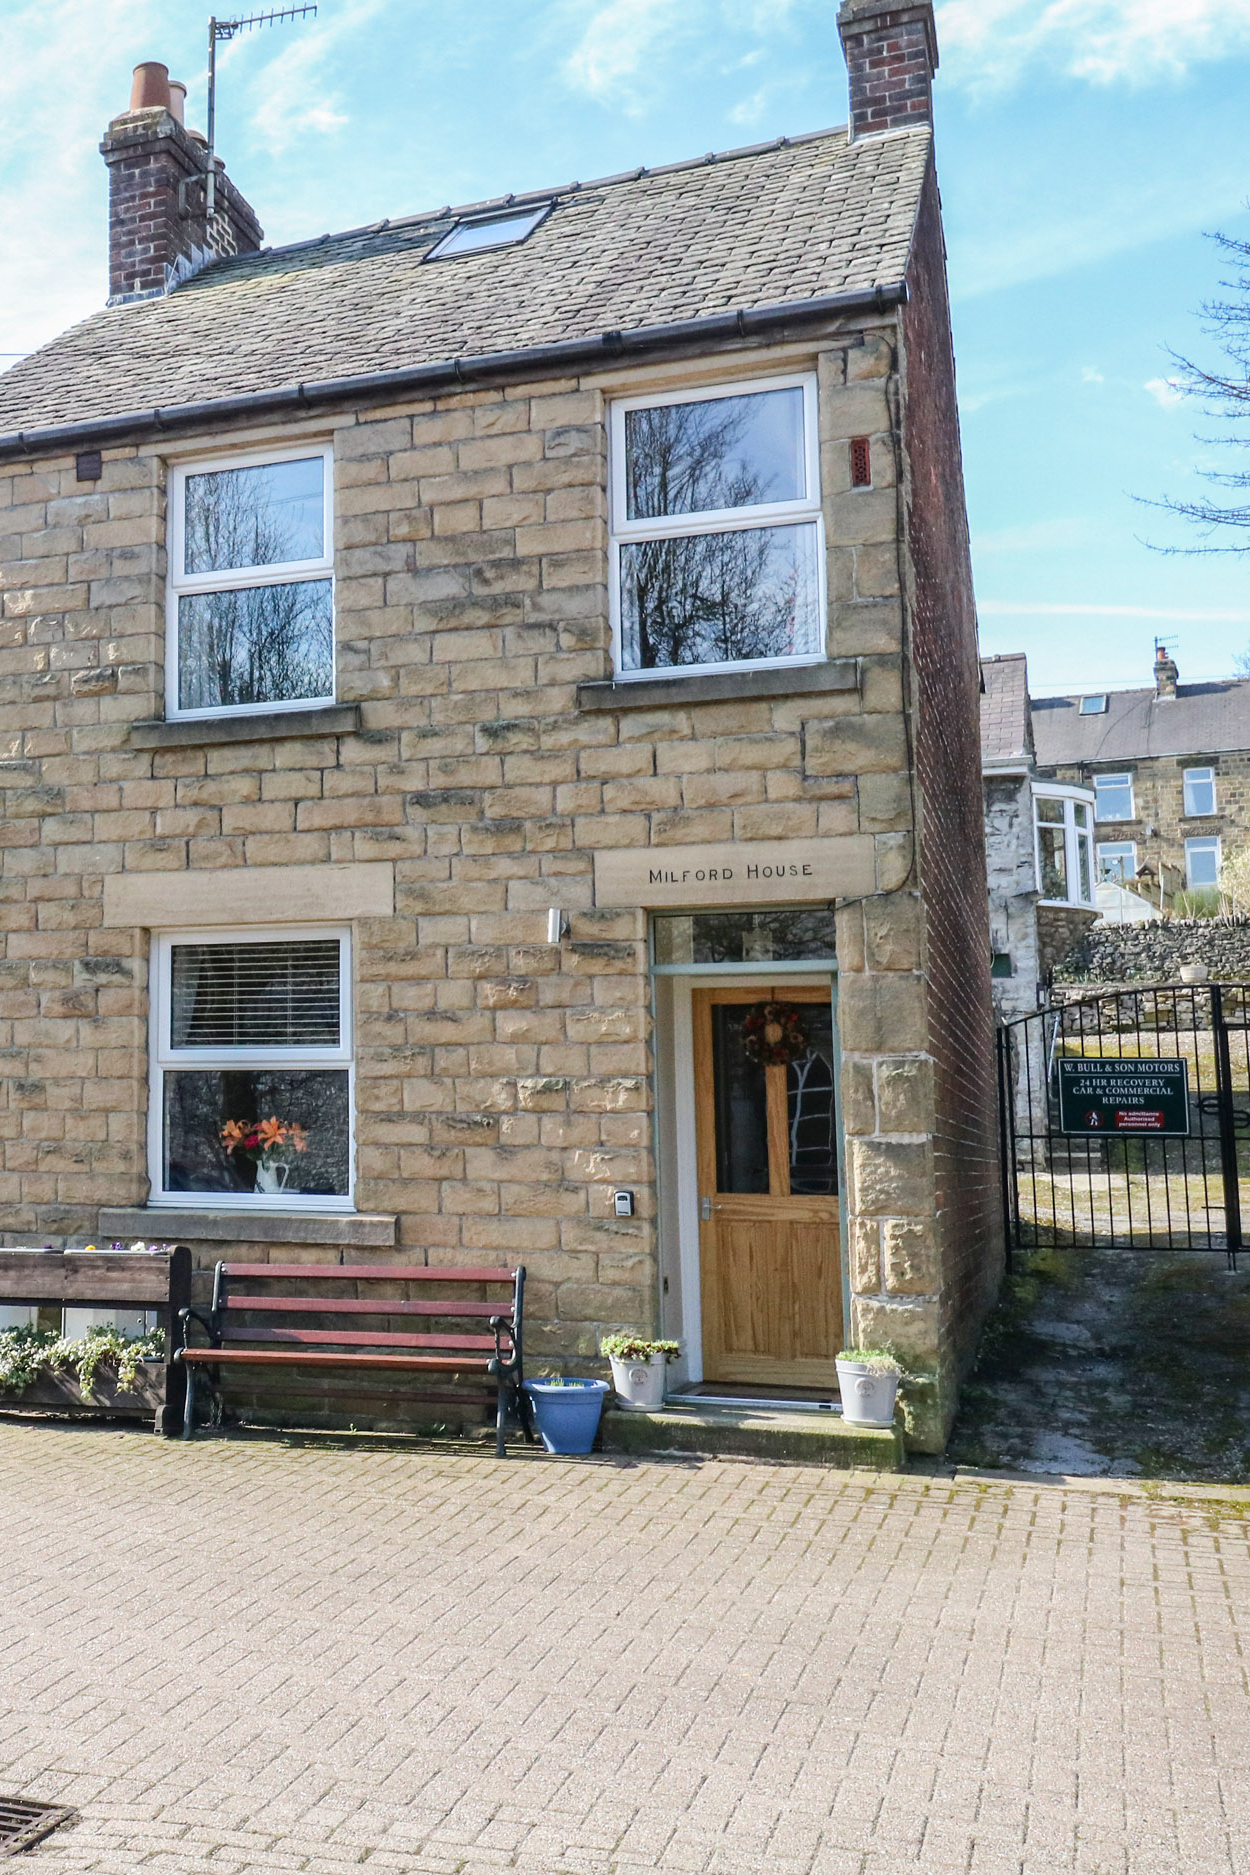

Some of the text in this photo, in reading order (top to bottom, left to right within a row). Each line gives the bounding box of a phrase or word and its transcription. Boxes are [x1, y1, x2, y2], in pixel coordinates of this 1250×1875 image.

[649, 864, 813, 884] MILFORD HOUSE
[1063, 1063, 1180, 1072] W. BULL & SON MOTORS
[1072, 1087, 1174, 1095] CAR & COMMERCIAL
[1102, 1096, 1145, 1105] REPAIRS
